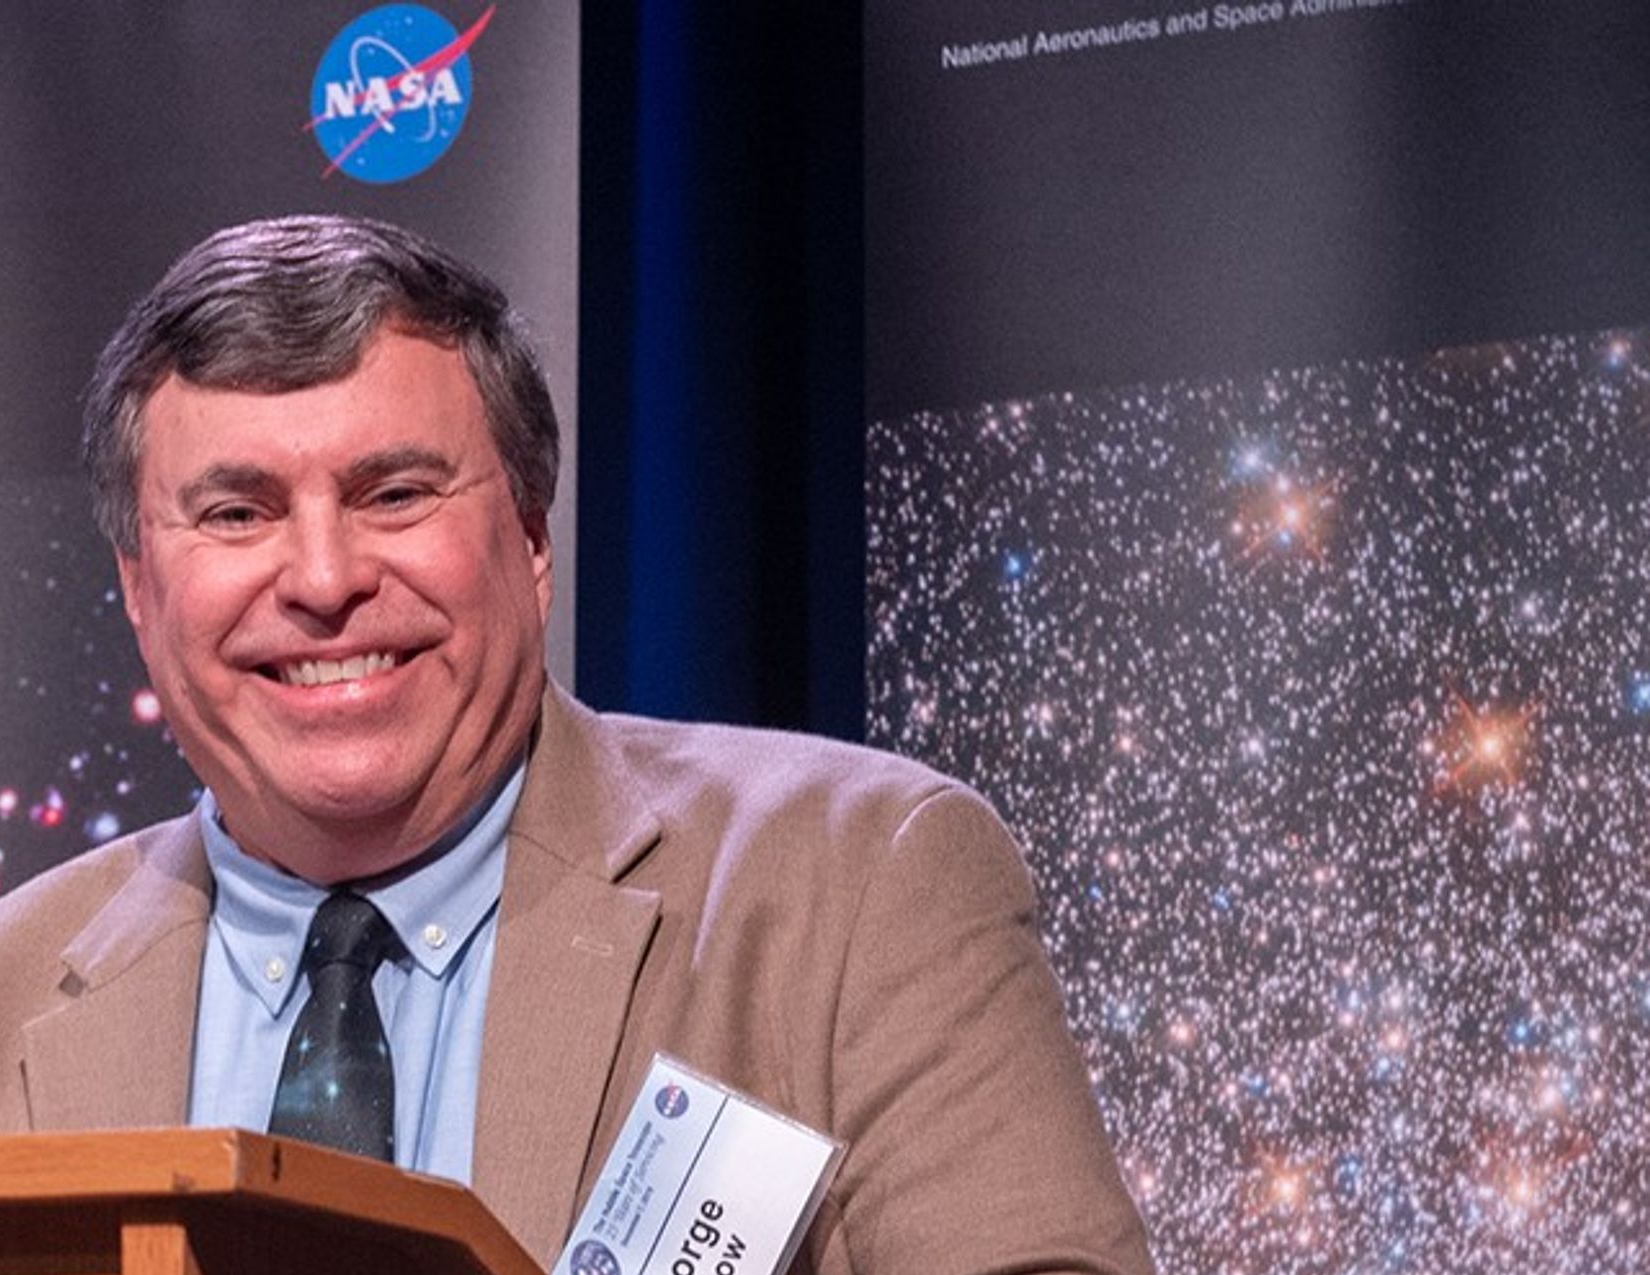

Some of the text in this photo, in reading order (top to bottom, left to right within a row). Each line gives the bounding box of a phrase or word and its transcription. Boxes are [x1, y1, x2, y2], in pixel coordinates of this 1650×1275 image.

[942, 35, 1029, 68] National
[1033, 20, 1161, 55] Aeronautics
[1166, 9, 1208, 36] and
[1213, 2, 1285, 32] Space
[324, 67, 463, 119] NASA
